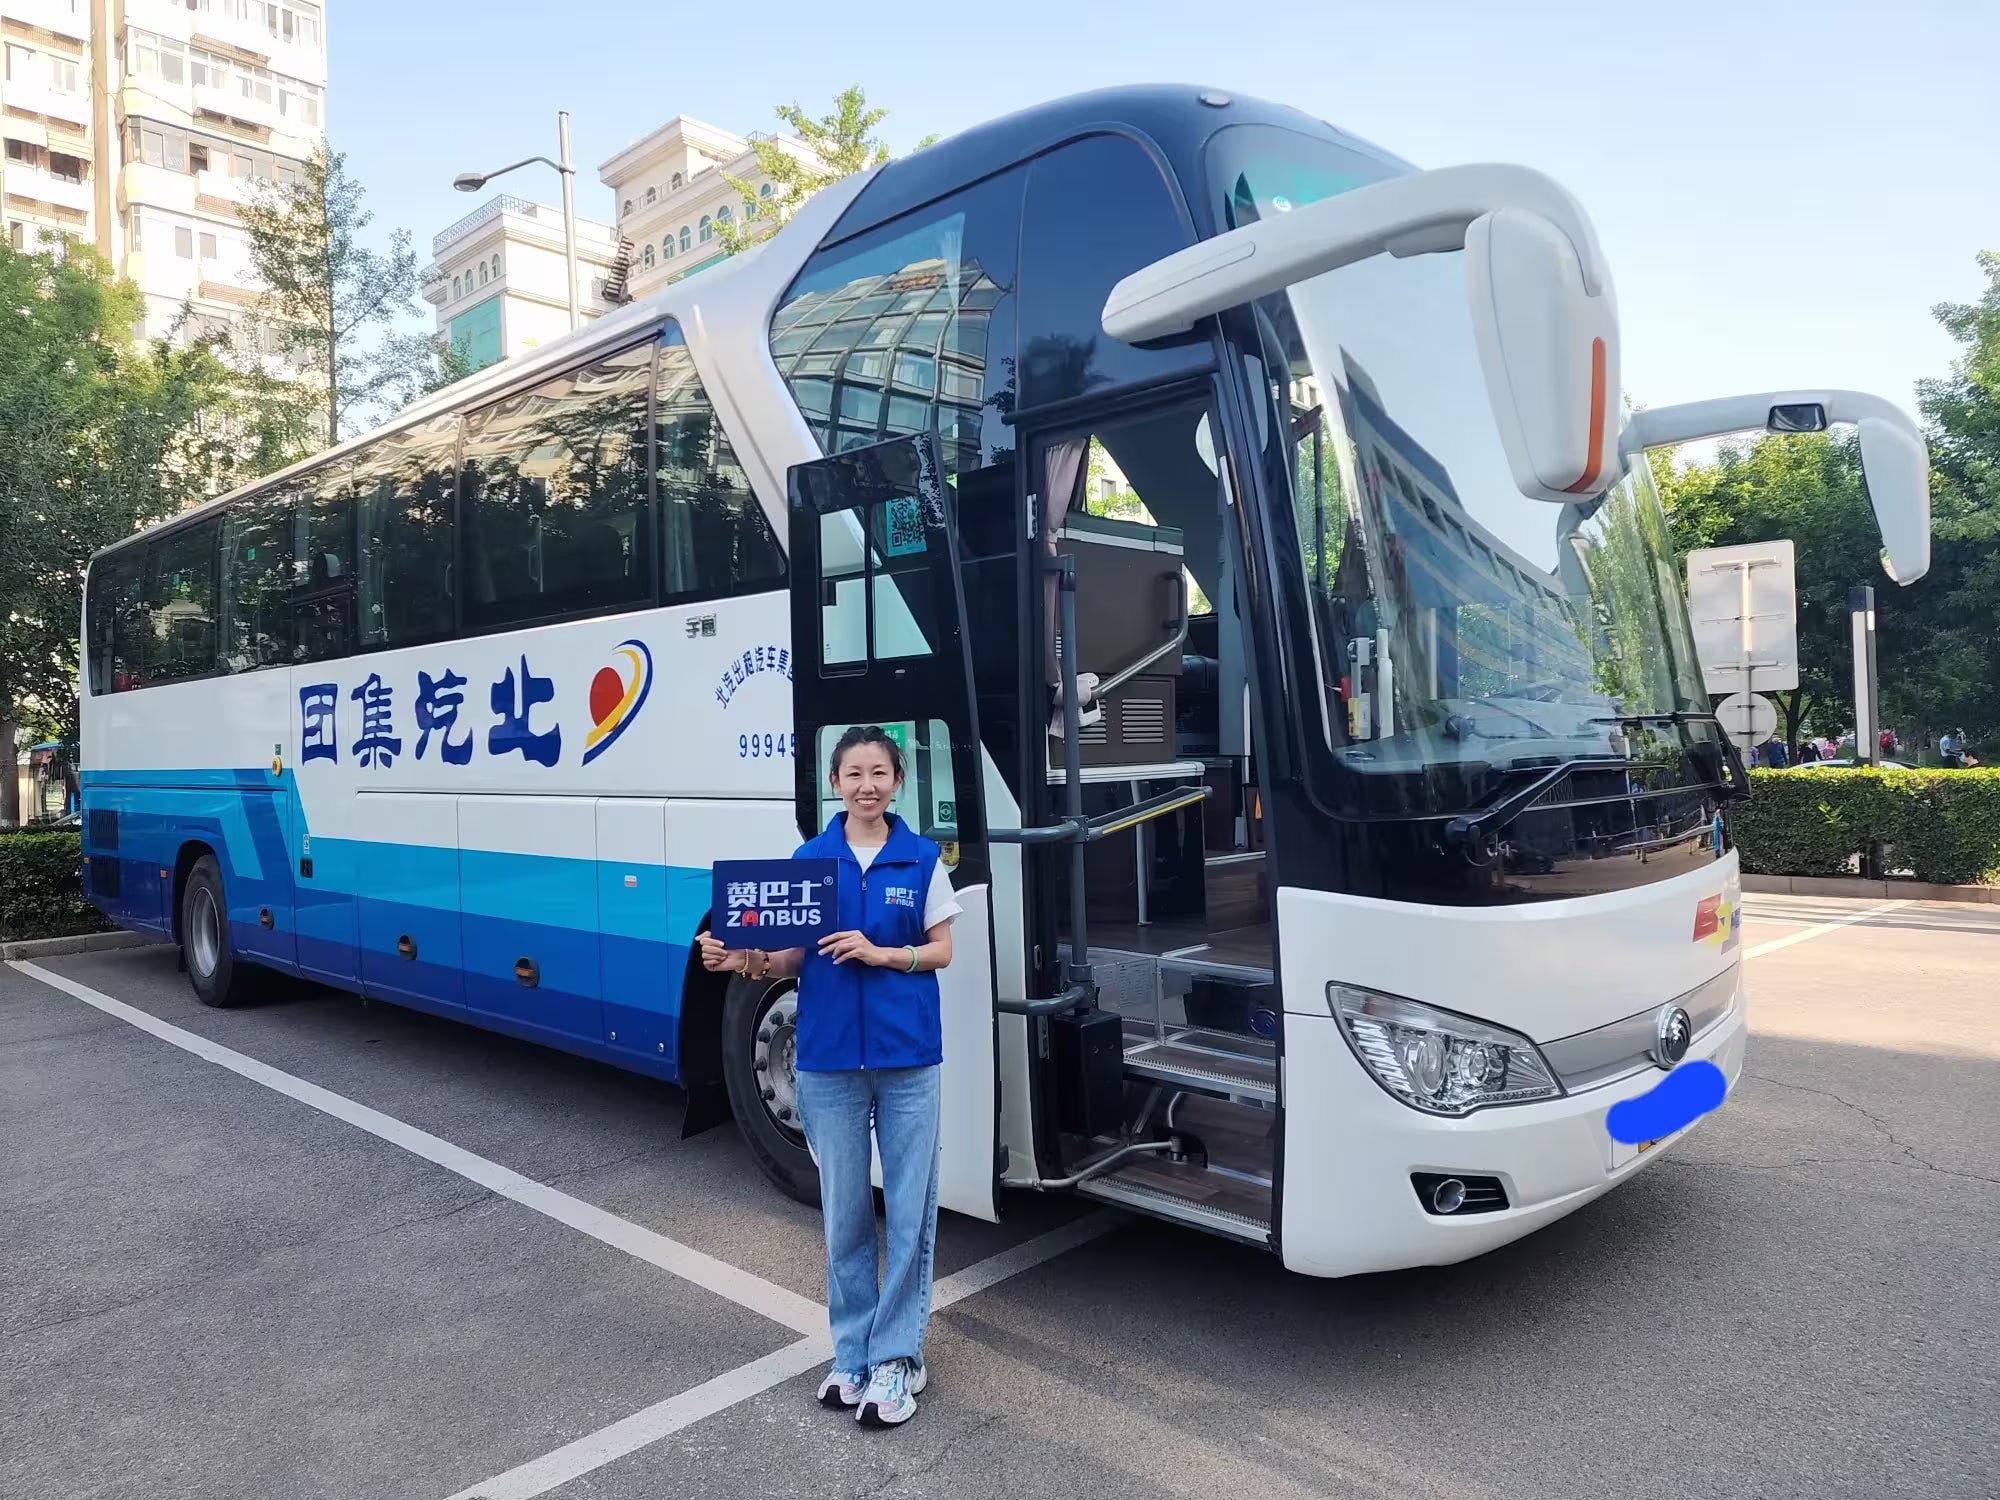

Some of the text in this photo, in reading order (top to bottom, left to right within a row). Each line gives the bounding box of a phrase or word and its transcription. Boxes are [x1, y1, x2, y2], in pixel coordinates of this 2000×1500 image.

[726, 880, 823, 908] 赞巴士
[726, 909, 822, 928] ZANBUS
